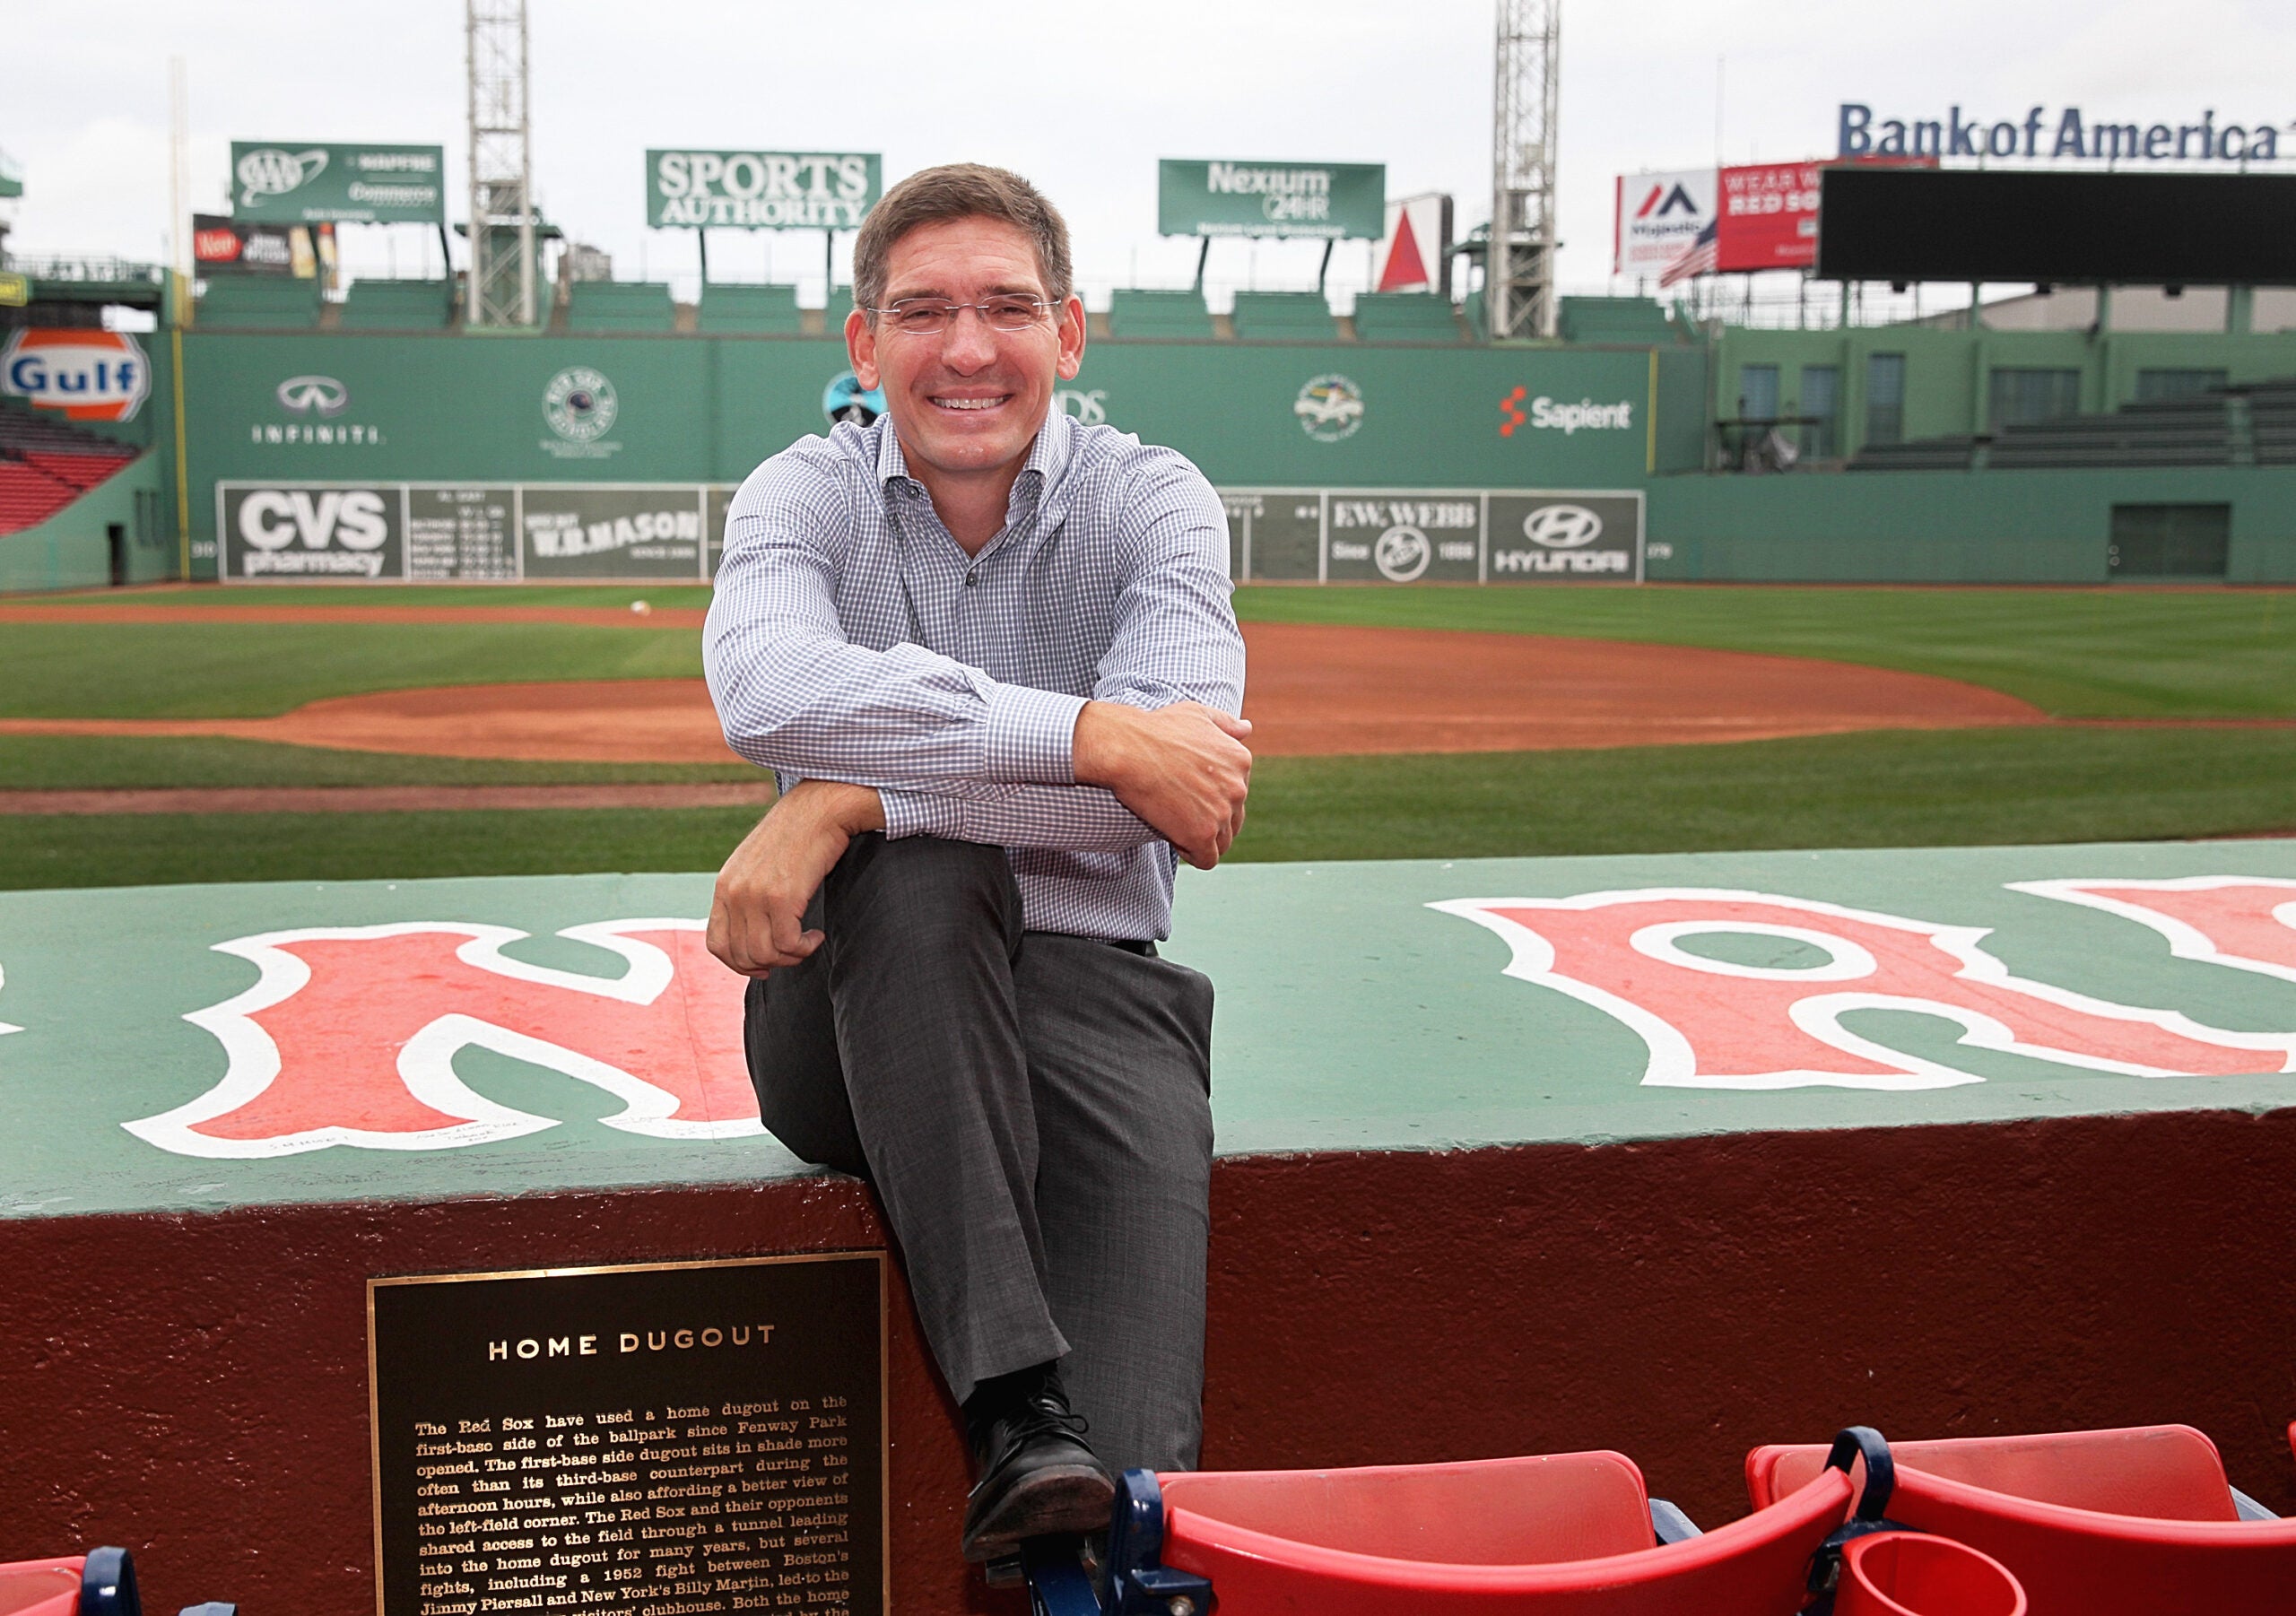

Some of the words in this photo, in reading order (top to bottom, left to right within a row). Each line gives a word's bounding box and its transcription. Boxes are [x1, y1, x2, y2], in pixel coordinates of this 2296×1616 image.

[1839, 104, 1974, 157] Bank
[1988, 107, 2045, 158] of
[2053, 108, 2278, 161] America
[658, 152, 868, 199] SPORTS
[1208, 162, 1331, 194] Nexium
[1724, 169, 1796, 194] WEAR
[661, 198, 867, 224] AUTHORITY
[1727, 193, 1783, 215] RED
[1785, 191, 1822, 213] SO
[11, 356, 136, 393] Gulf
[251, 424, 378, 445] INFINITI
[1530, 395, 1632, 435] Sapient
[239, 490, 387, 550] CVS
[1389, 501, 1476, 528] WEBB
[242, 549, 386, 578] pharmacy
[1494, 551, 1629, 572] HYUNDAI
[489, 1334, 597, 1361] HOME
[620, 1325, 775, 1353] DUGOUT
[414, 1422, 447, 1437] The
[457, 1418, 491, 1434] Red
[501, 1417, 535, 1431] Sox
[544, 1413, 584, 1429] have
[595, 1409, 634, 1424] used
[645, 1410, 656, 1421] a
[666, 1405, 710, 1420] home
[721, 1400, 779, 1417] dugout
[789, 1399, 811, 1411] on
[822, 1395, 847, 1409] the
[415, 1441, 493, 1456] first-base
[502, 1437, 536, 1451] side
[545, 1433, 564, 1448] of
[572, 1432, 599, 1446] the
[608, 1427, 676, 1444] ballpark
[686, 1424, 727, 1438] since
[737, 1421, 799, 1434] Fenway
[808, 1414, 847, 1429] Park
[416, 1460, 479, 1479] opened.
[483, 1458, 517, 1472] The
[520, 1454, 597, 1469] first-base
[601, 1449, 634, 1464] side
[639, 1445, 698, 1462] dugout
[701, 1443, 731, 1456] sits
[735, 1441, 752, 1454] in
[757, 1437, 803, 1452] shade
[807, 1436, 848, 1448] more
[416, 1482, 460, 1497] often
[471, 1479, 511, 1493] than
[522, 1476, 544, 1490] its
[555, 1471, 638, 1487] third-base
[649, 1462, 744, 1480] counterpart
[755, 1457, 811, 1472] during
[822, 1454, 848, 1467] the
[417, 1501, 498, 1516] afternoon
[501, 1497, 556, 1510] hours,
[561, 1490, 605, 1506] while
[610, 1489, 642, 1503] also
[647, 1483, 723, 1499] affording
[726, 1483, 737, 1493] a
[741, 1479, 787, 1492] better
[792, 1475, 828, 1488] view
[831, 1472, 849, 1485] of
[418, 1523, 446, 1536] the
[448, 1516, 519, 1534] left-field
[523, 1515, 579, 1529] corner.
[584, 1510, 616, 1525] The
[620, 1507, 651, 1522] Red
[655, 1506, 685, 1518] Sox
[690, 1501, 720, 1516] and
[725, 1499, 763, 1513] their
[768, 1493, 848, 1512] opponents
[419, 1540, 475, 1556] shared
[482, 1538, 534, 1551] access
[540, 1534, 558, 1548] to
[563, 1532, 591, 1545] the
[597, 1527, 634, 1542] field
[640, 1522, 707, 1539] through
[714, 1523, 725, 1533] a
[731, 1516, 783, 1532] tunnel
[790, 1512, 848, 1527] leading
[419, 1562, 453, 1577] into
[461, 1560, 489, 1573] the
[495, 1557, 542, 1570] home
[549, 1550, 609, 1568] dugout
[616, 1547, 641, 1561] for
[648, 1545, 694, 1558] many
[702, 1541, 751, 1557] years,
[758, 1535, 786, 1549] but
[793, 1530, 848, 1546] several
[420, 1580, 474, 1598] fights,
[487, 1574, 568, 1591] including
[579, 1573, 590, 1584] a
[604, 1567, 642, 1582] 1952
[655, 1562, 695, 1579] fight
[707, 1558, 770, 1573] between
[783, 1550, 848, 1567] Boston's
[420, 1602, 477, 1616] Jimmy
[480, 1594, 544, 1612] Piersall
[546, 1590, 578, 1606] and
[579, 1589, 616, 1603] New
[620, 1584, 671, 1600] York's
[674, 1580, 712, 1595] Billy
[715, 1576, 774, 1593] Martin,
[778, 1572, 801, 1586] led
[805, 1572, 822, 1584] to
[823, 1568, 849, 1582] the
[571, 1606, 636, 1616] iitors'
[642, 1601, 726, 1616] clubhouse.
[733, 1594, 770, 1609] Both
[776, 1593, 801, 1605] the
[807, 1590, 850, 1603] home
